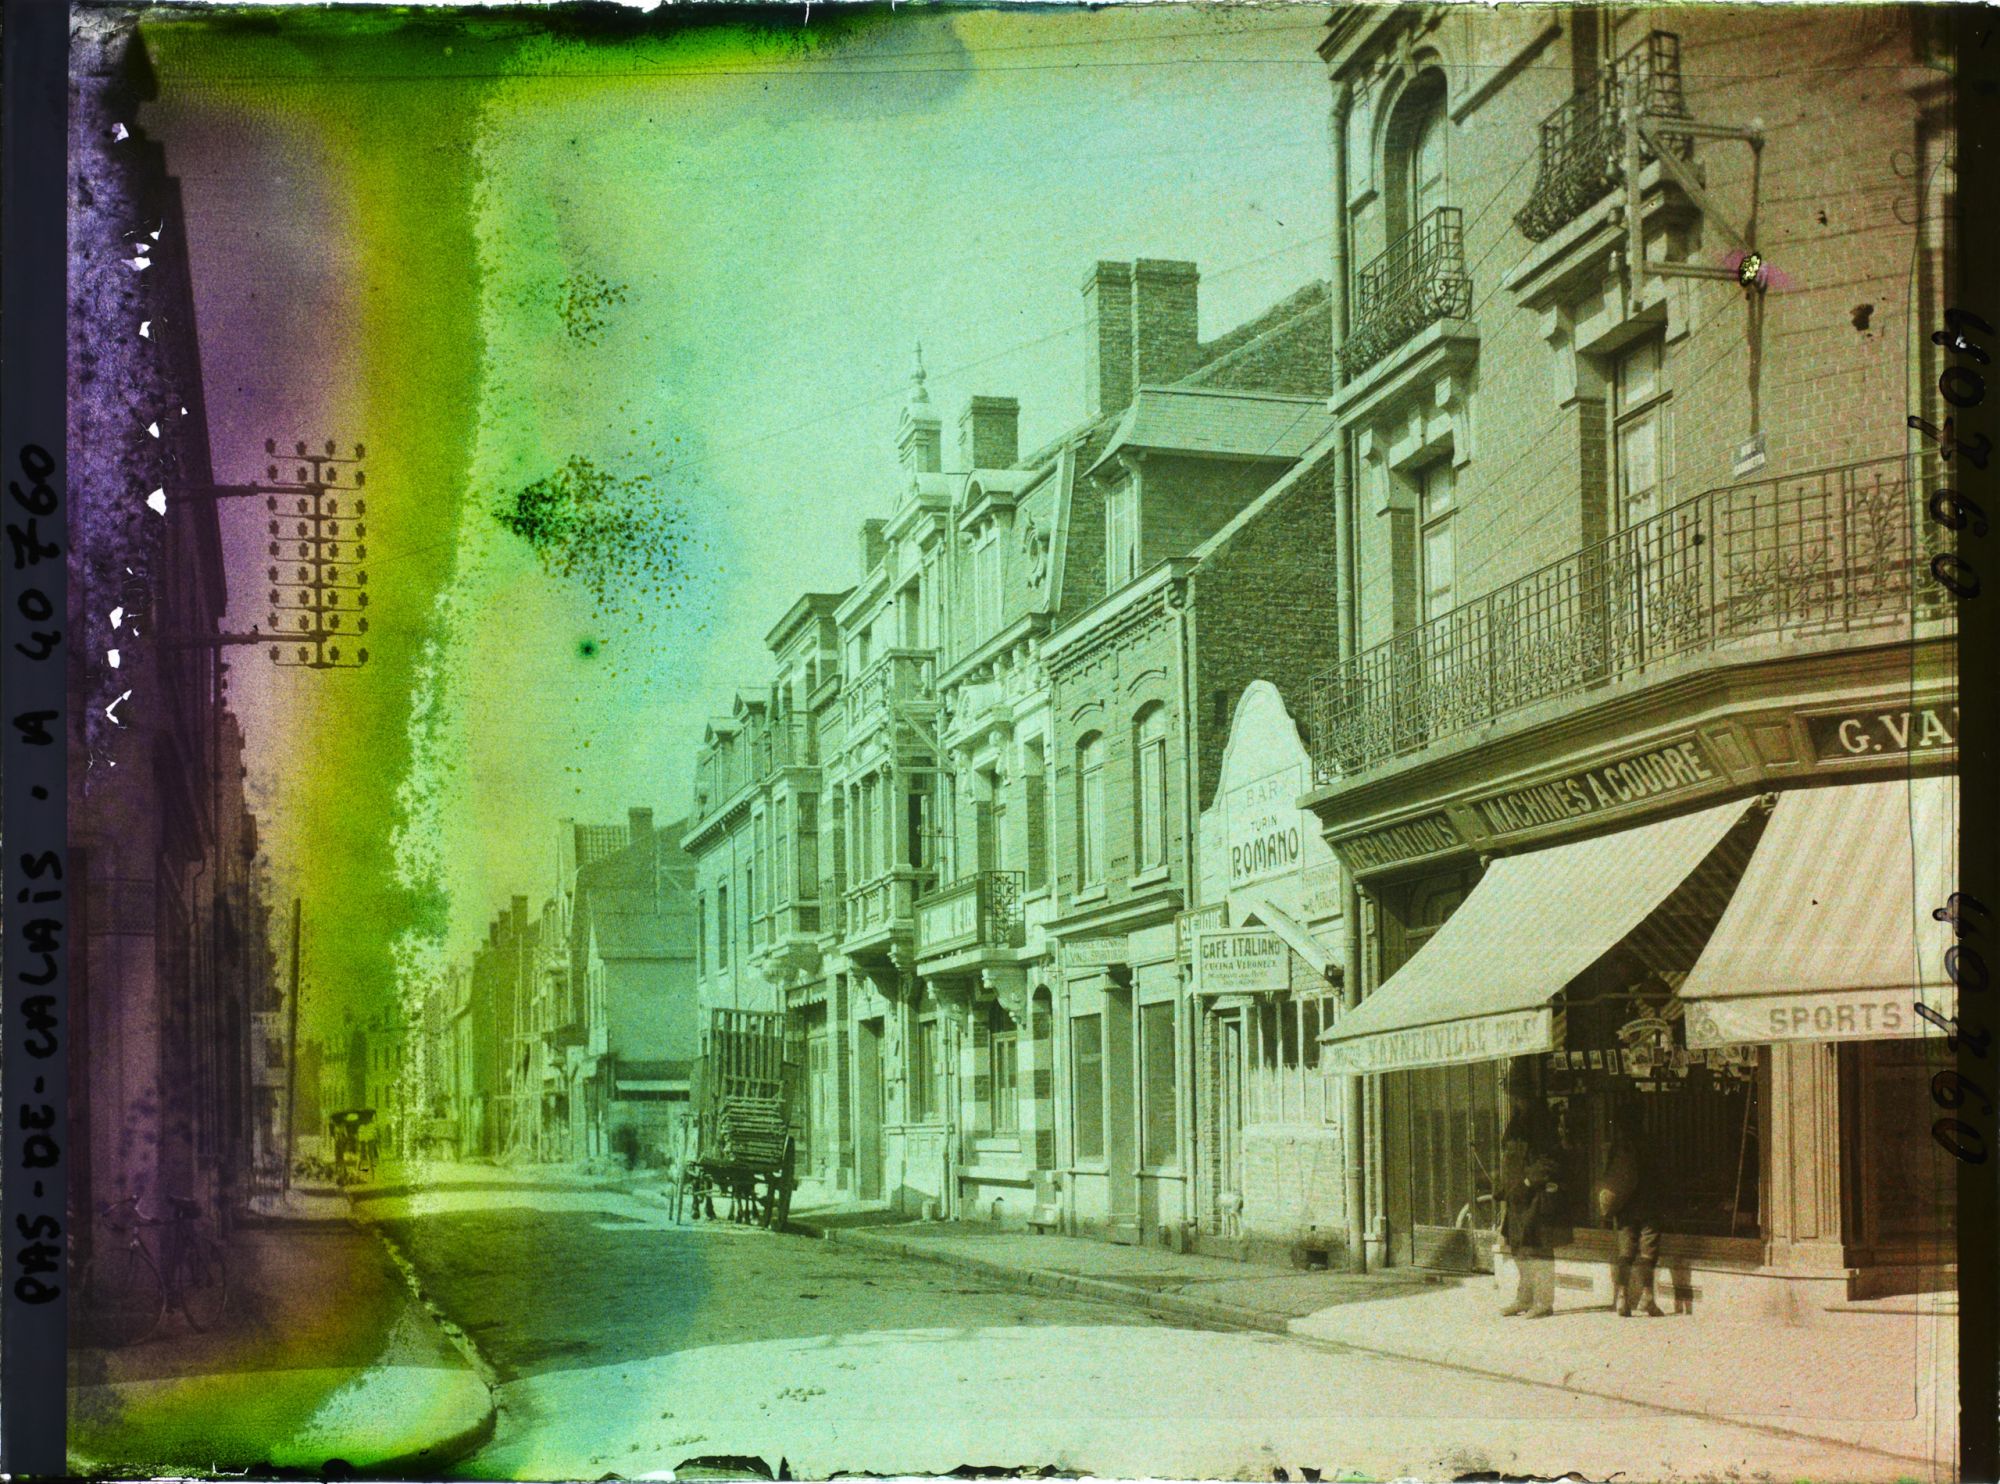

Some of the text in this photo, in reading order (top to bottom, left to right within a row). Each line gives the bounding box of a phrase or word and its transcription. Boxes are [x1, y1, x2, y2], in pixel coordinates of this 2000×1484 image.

[1839, 706, 1960, 754] G.VA
[1480, 741, 1713, 834] MACHINES A COUDRE
[1232, 826, 1299, 879] ROMANO
[1343, 815, 1460, 871] REPARATIONS
[1202, 936, 1281, 959] CAFE ITALIANO
[1768, 1001, 1901, 1036] SPORTS
